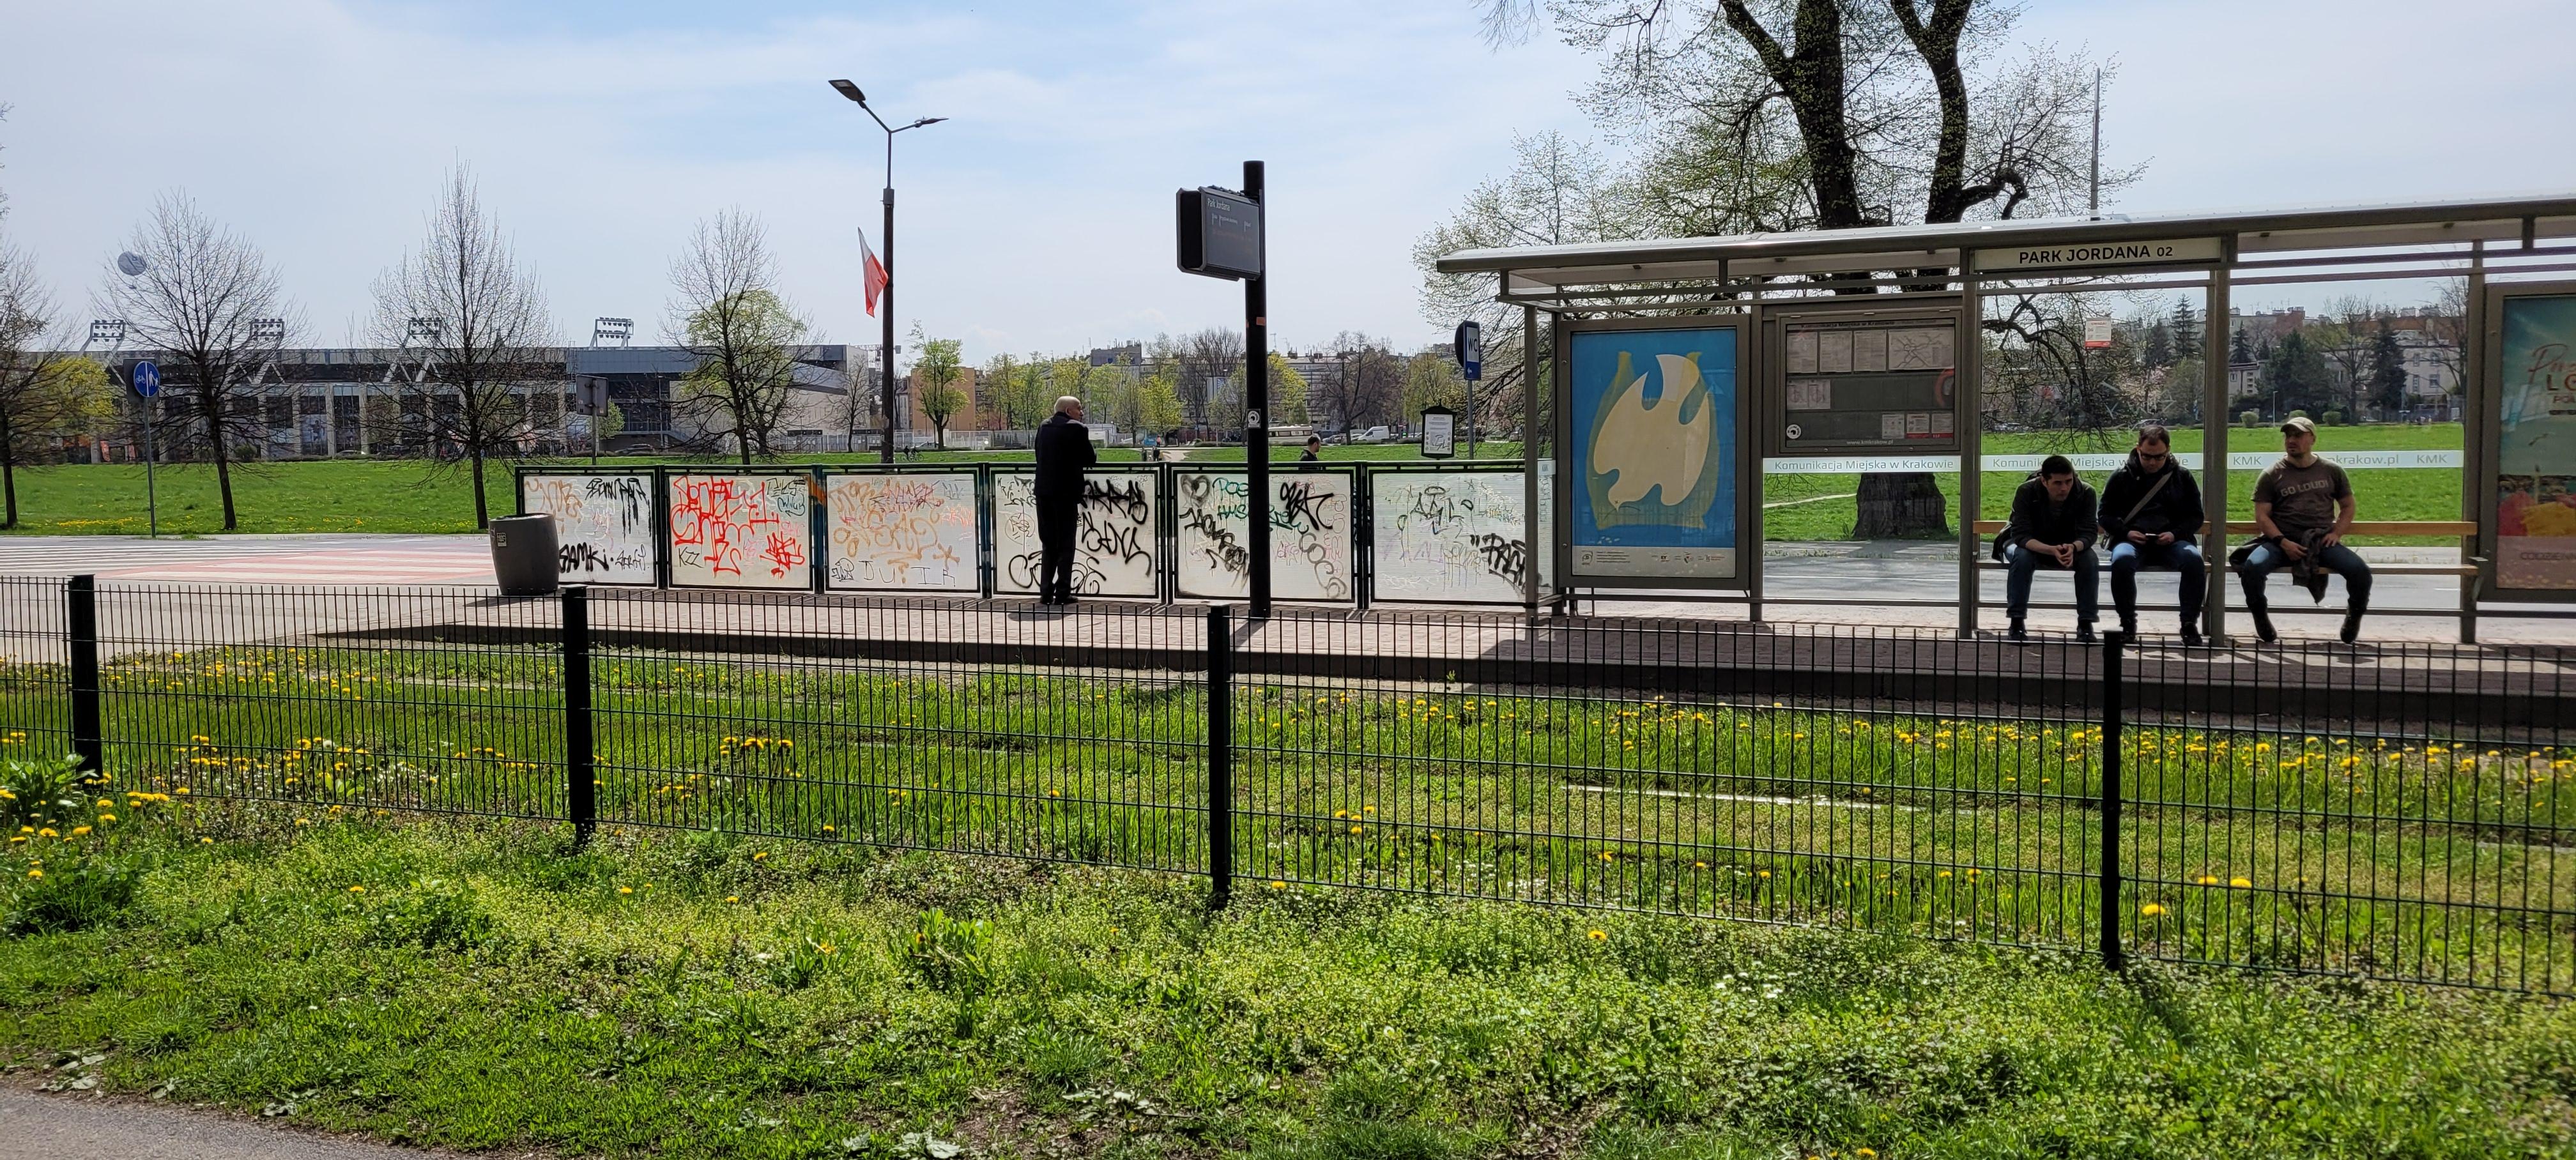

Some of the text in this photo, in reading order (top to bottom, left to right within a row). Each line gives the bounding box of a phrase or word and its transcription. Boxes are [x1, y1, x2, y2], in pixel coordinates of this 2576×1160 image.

[2019, 245, 2174, 264] PARK JORDANA 02
[1468, 338, 1478, 353] WC
[1775, 461, 1843, 470] Komunikacja
[1845, 460, 1886, 471] Miejska
[1902, 459, 1954, 469] Krakowie
[1993, 458, 2043, 468] Komunik
[2071, 457, 2115, 469] Miejska
[2233, 456, 2262, 465] KMK
[2417, 455, 2448, 464] KMK
[2280, 480, 2329, 497] GO LOUD!
